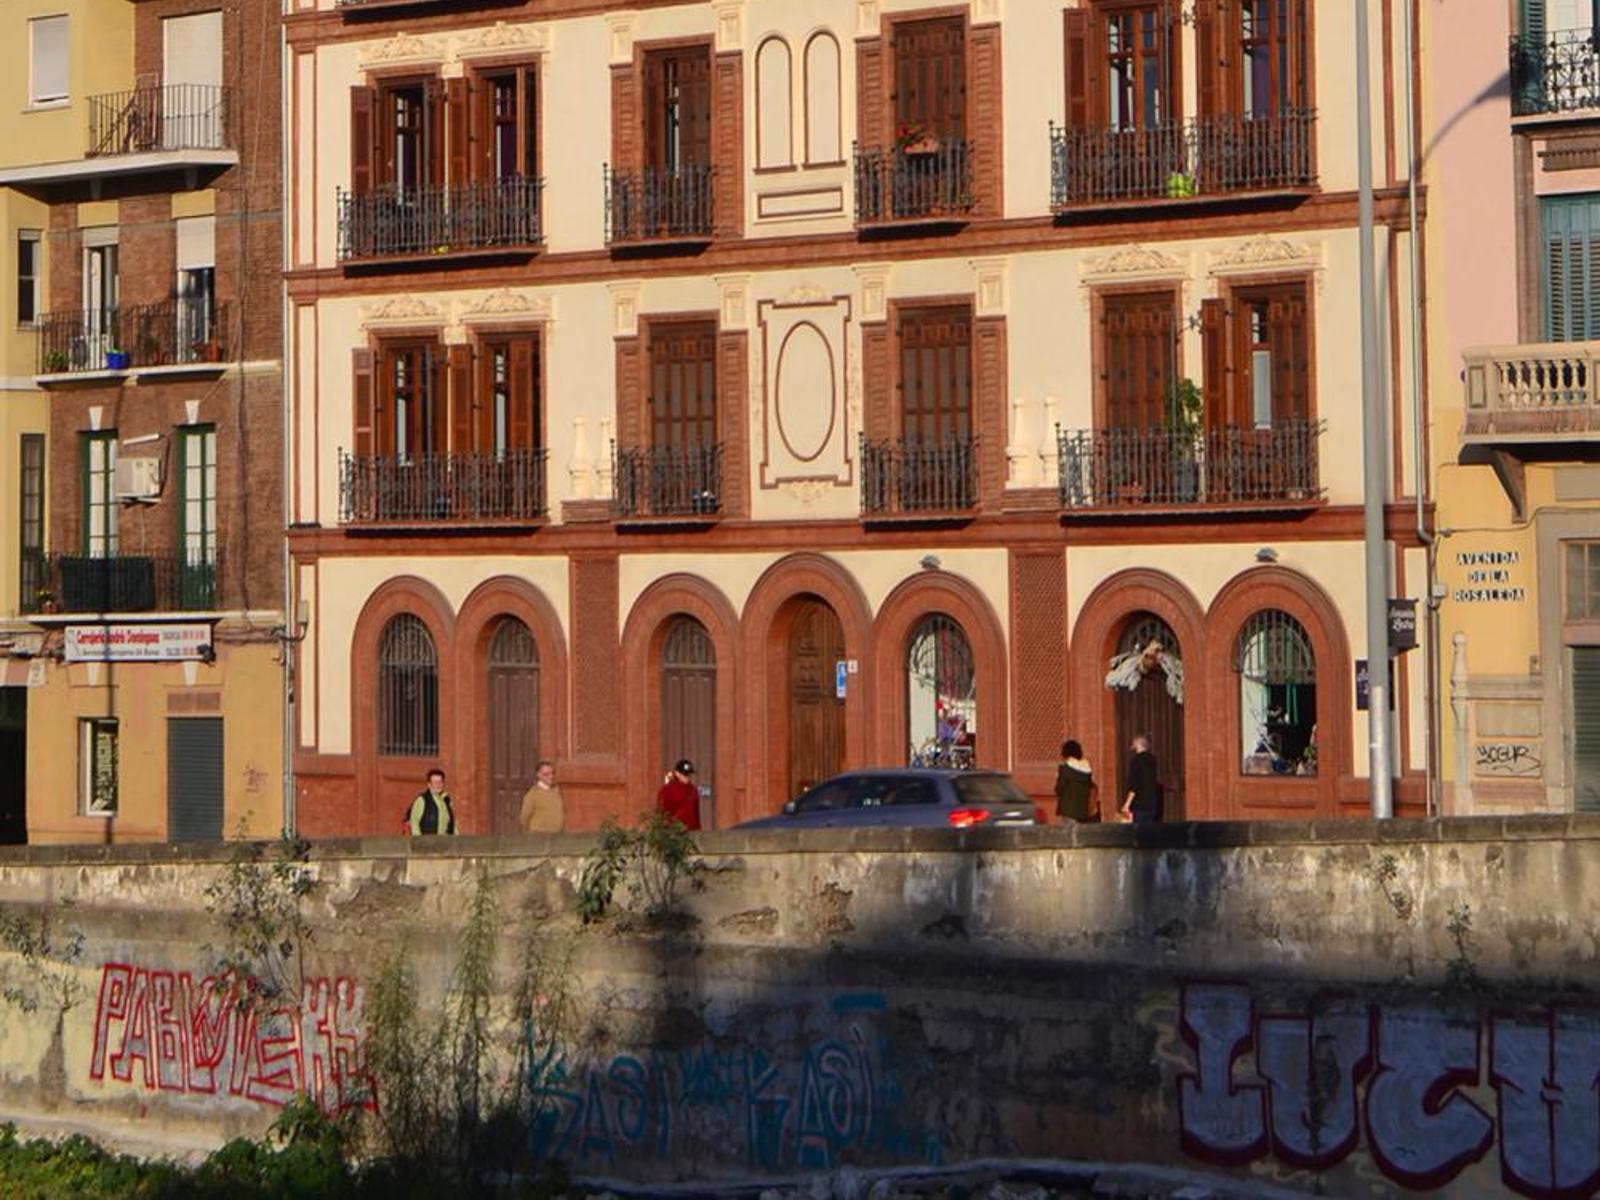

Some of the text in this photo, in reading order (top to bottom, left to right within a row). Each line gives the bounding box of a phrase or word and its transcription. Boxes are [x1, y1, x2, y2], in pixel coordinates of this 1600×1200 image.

[1456, 551, 1520, 566] AVENIDA
[1467, 570, 1510, 583] DE LA
[1455, 588, 1525, 602] ROSALEDA
